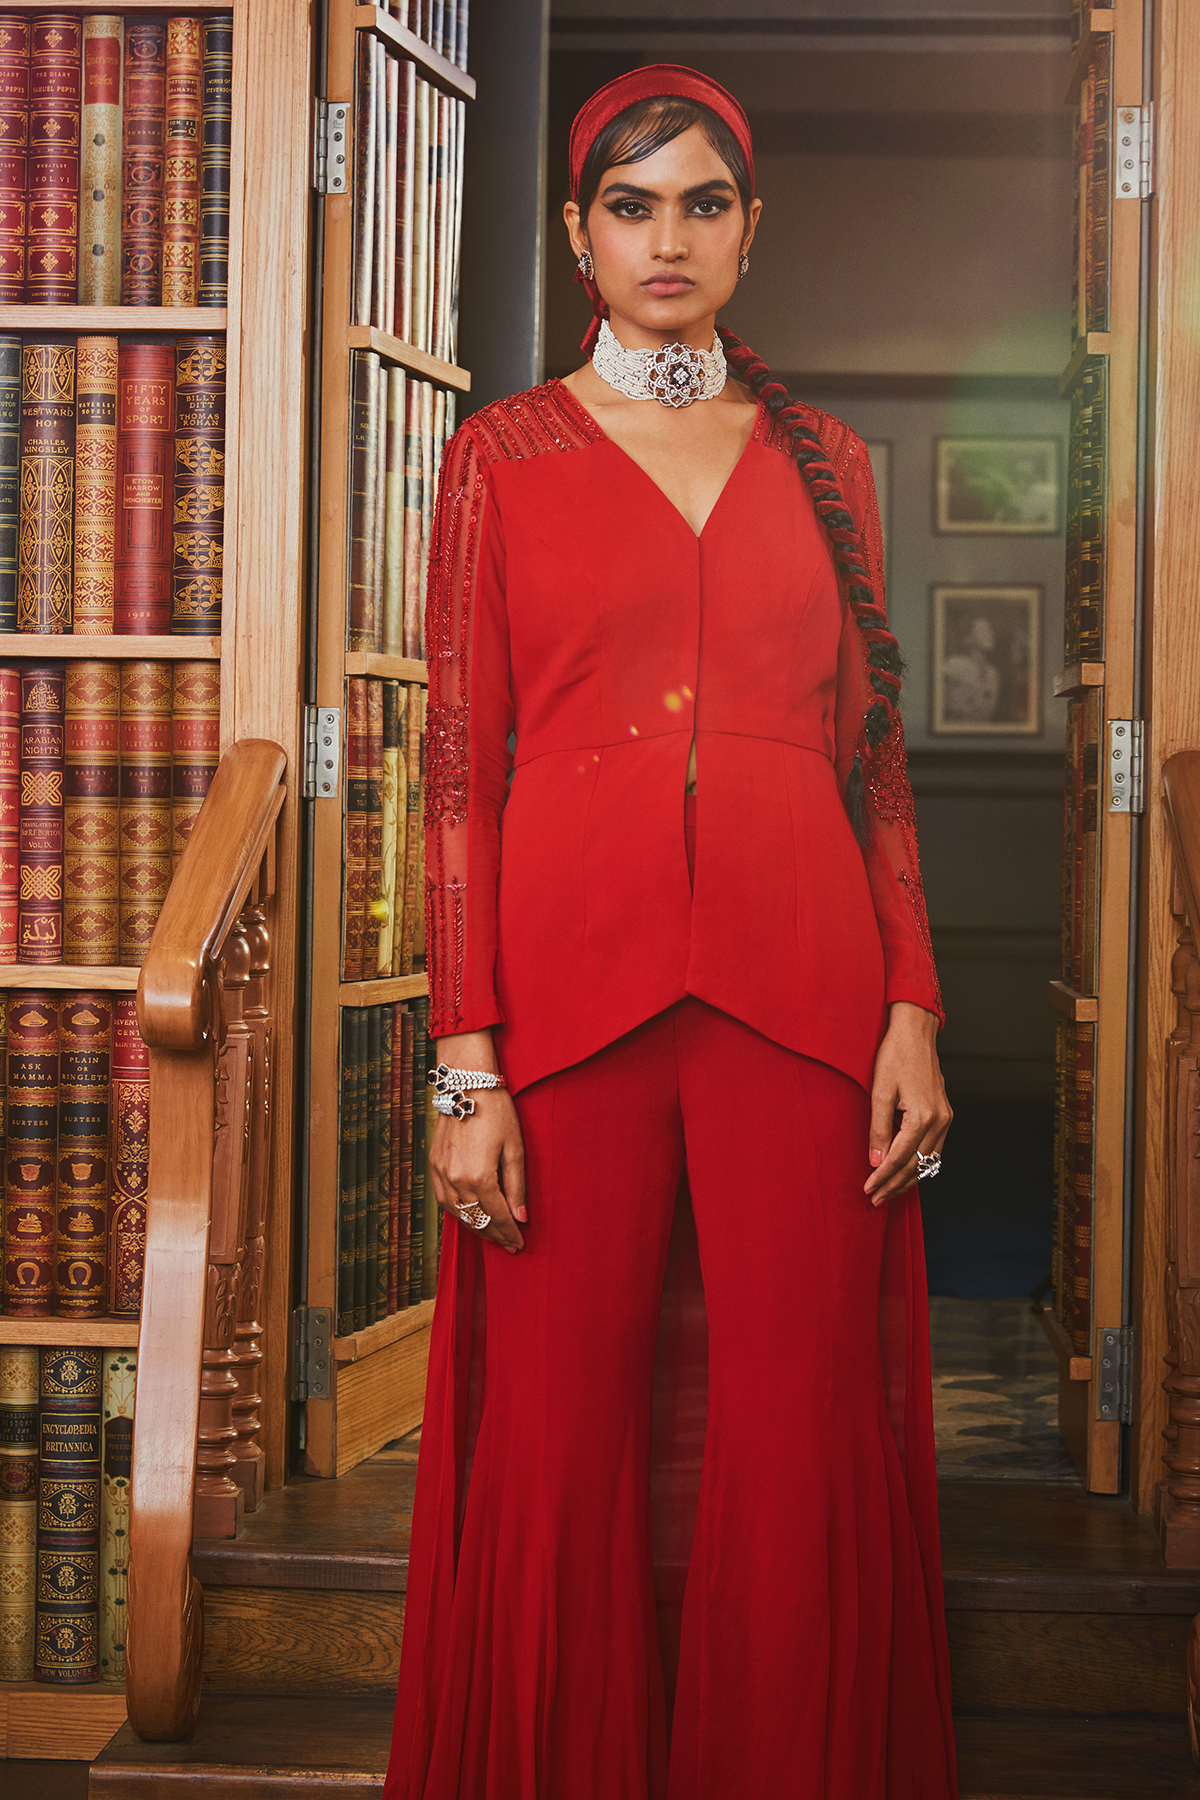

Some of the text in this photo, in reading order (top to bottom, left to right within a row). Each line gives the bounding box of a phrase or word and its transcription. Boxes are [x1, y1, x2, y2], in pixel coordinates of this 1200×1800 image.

[5, 85, 25, 94] PEPYS
[32, 85, 76, 93] SAMUEL PEPYS
[126, 384, 166, 394] FIFTY
[126, 396, 166, 405] YEARS
[185, 395, 216, 403] BILLY
[22, 407, 74, 418] WESTWARD
[179, 413, 220, 421] THOMAS
[35, 419, 57, 428] HO!
[125, 415, 165, 425] SPORT
[183, 419, 219, 427] ROHAN
[27, 438, 66, 446] CHARLES
[24, 446, 70, 454] KINGSLEY
[127, 611, 151, 620] 1922
[69, 724, 114, 732] BEAUMONT
[124, 725, 168, 733] BEAUMONT
[23, 736, 62, 745] ARABIAN
[25, 746, 60, 755] NIGHTS
[13, 1073, 52, 1081] MAMMA
[62, 1073, 108, 1081] RINGLETS
[45, 1441, 94, 1453] BRITANNICA
[41, 1668, 92, 1678] NEW VOLUMES
